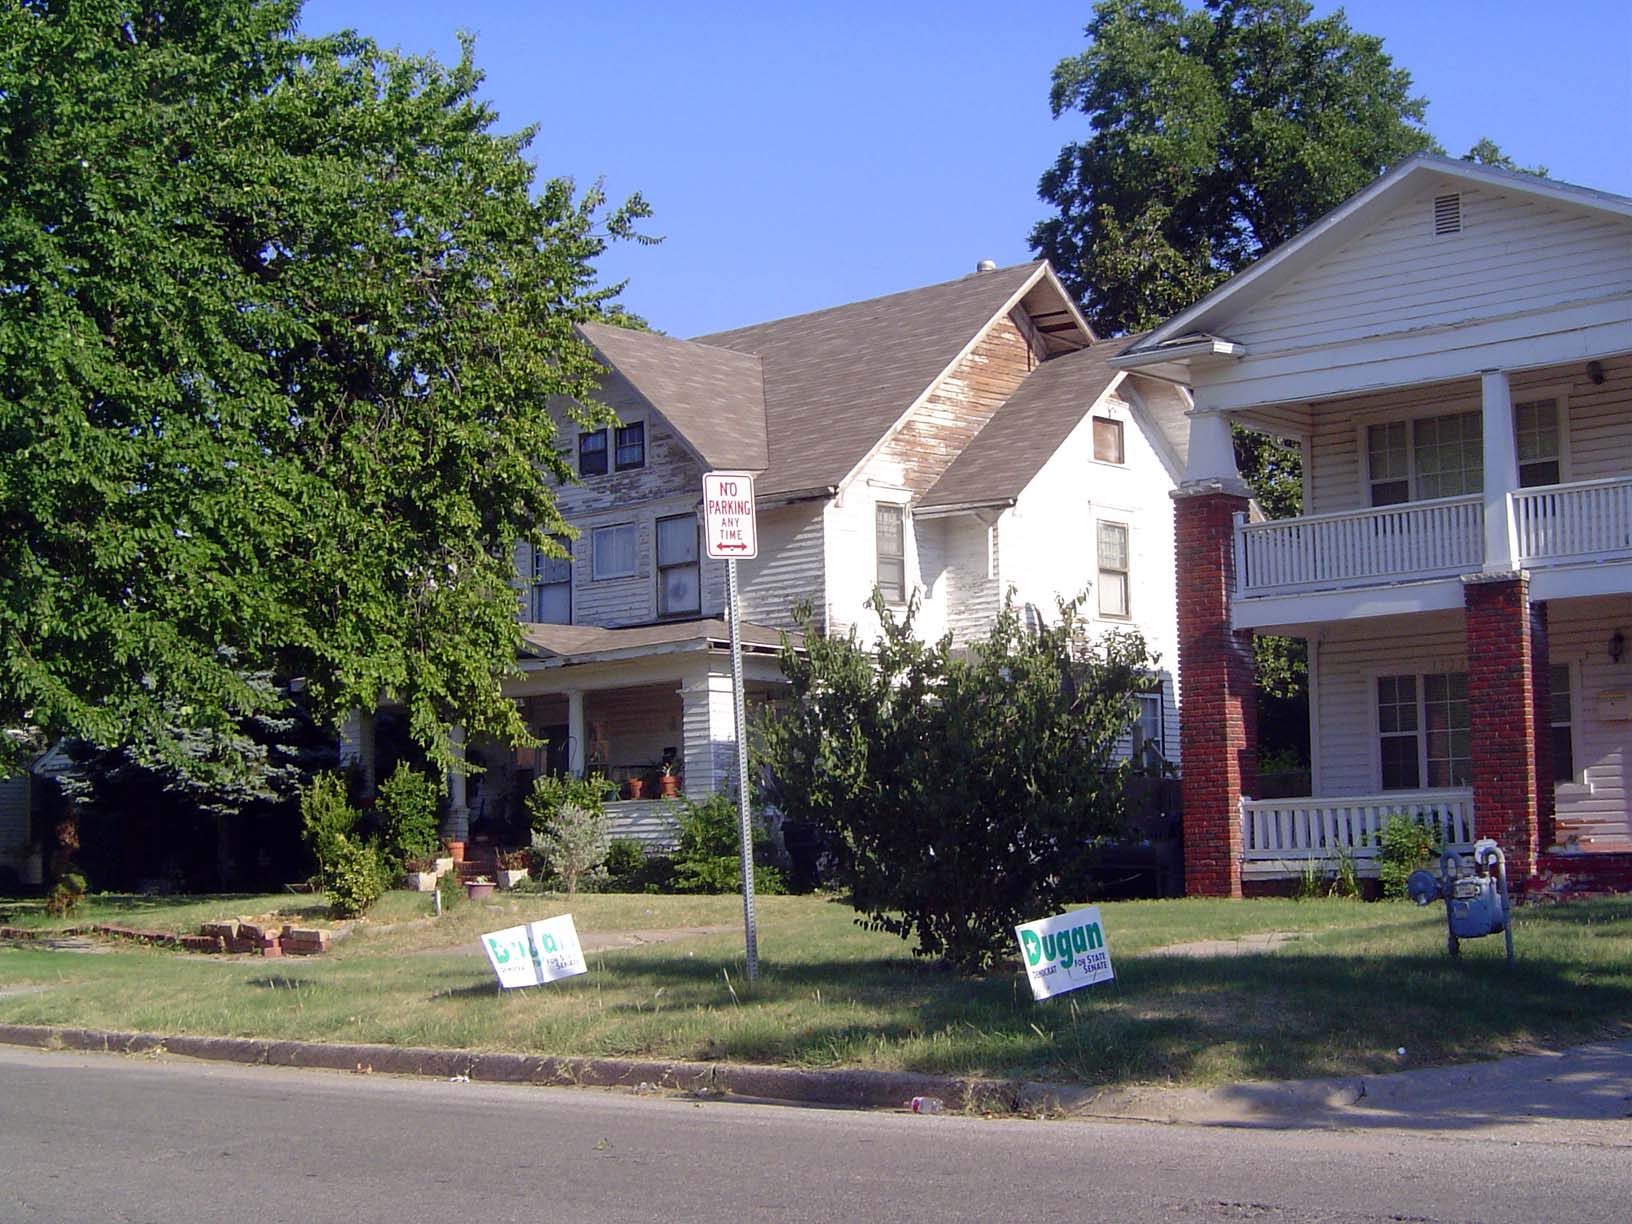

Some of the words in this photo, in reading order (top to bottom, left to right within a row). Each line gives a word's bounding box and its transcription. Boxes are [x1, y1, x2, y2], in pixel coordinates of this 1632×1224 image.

[719, 482, 738, 497] NO
[709, 500, 751, 515] PARKING
[721, 517, 740, 528] ANY
[720, 529, 743, 540] TIME
[1020, 922, 1104, 968] Dugan
[1074, 958, 1086, 967] FOR
[1086, 952, 1106, 964] STATE
[1083, 961, 1108, 974] SENATE
